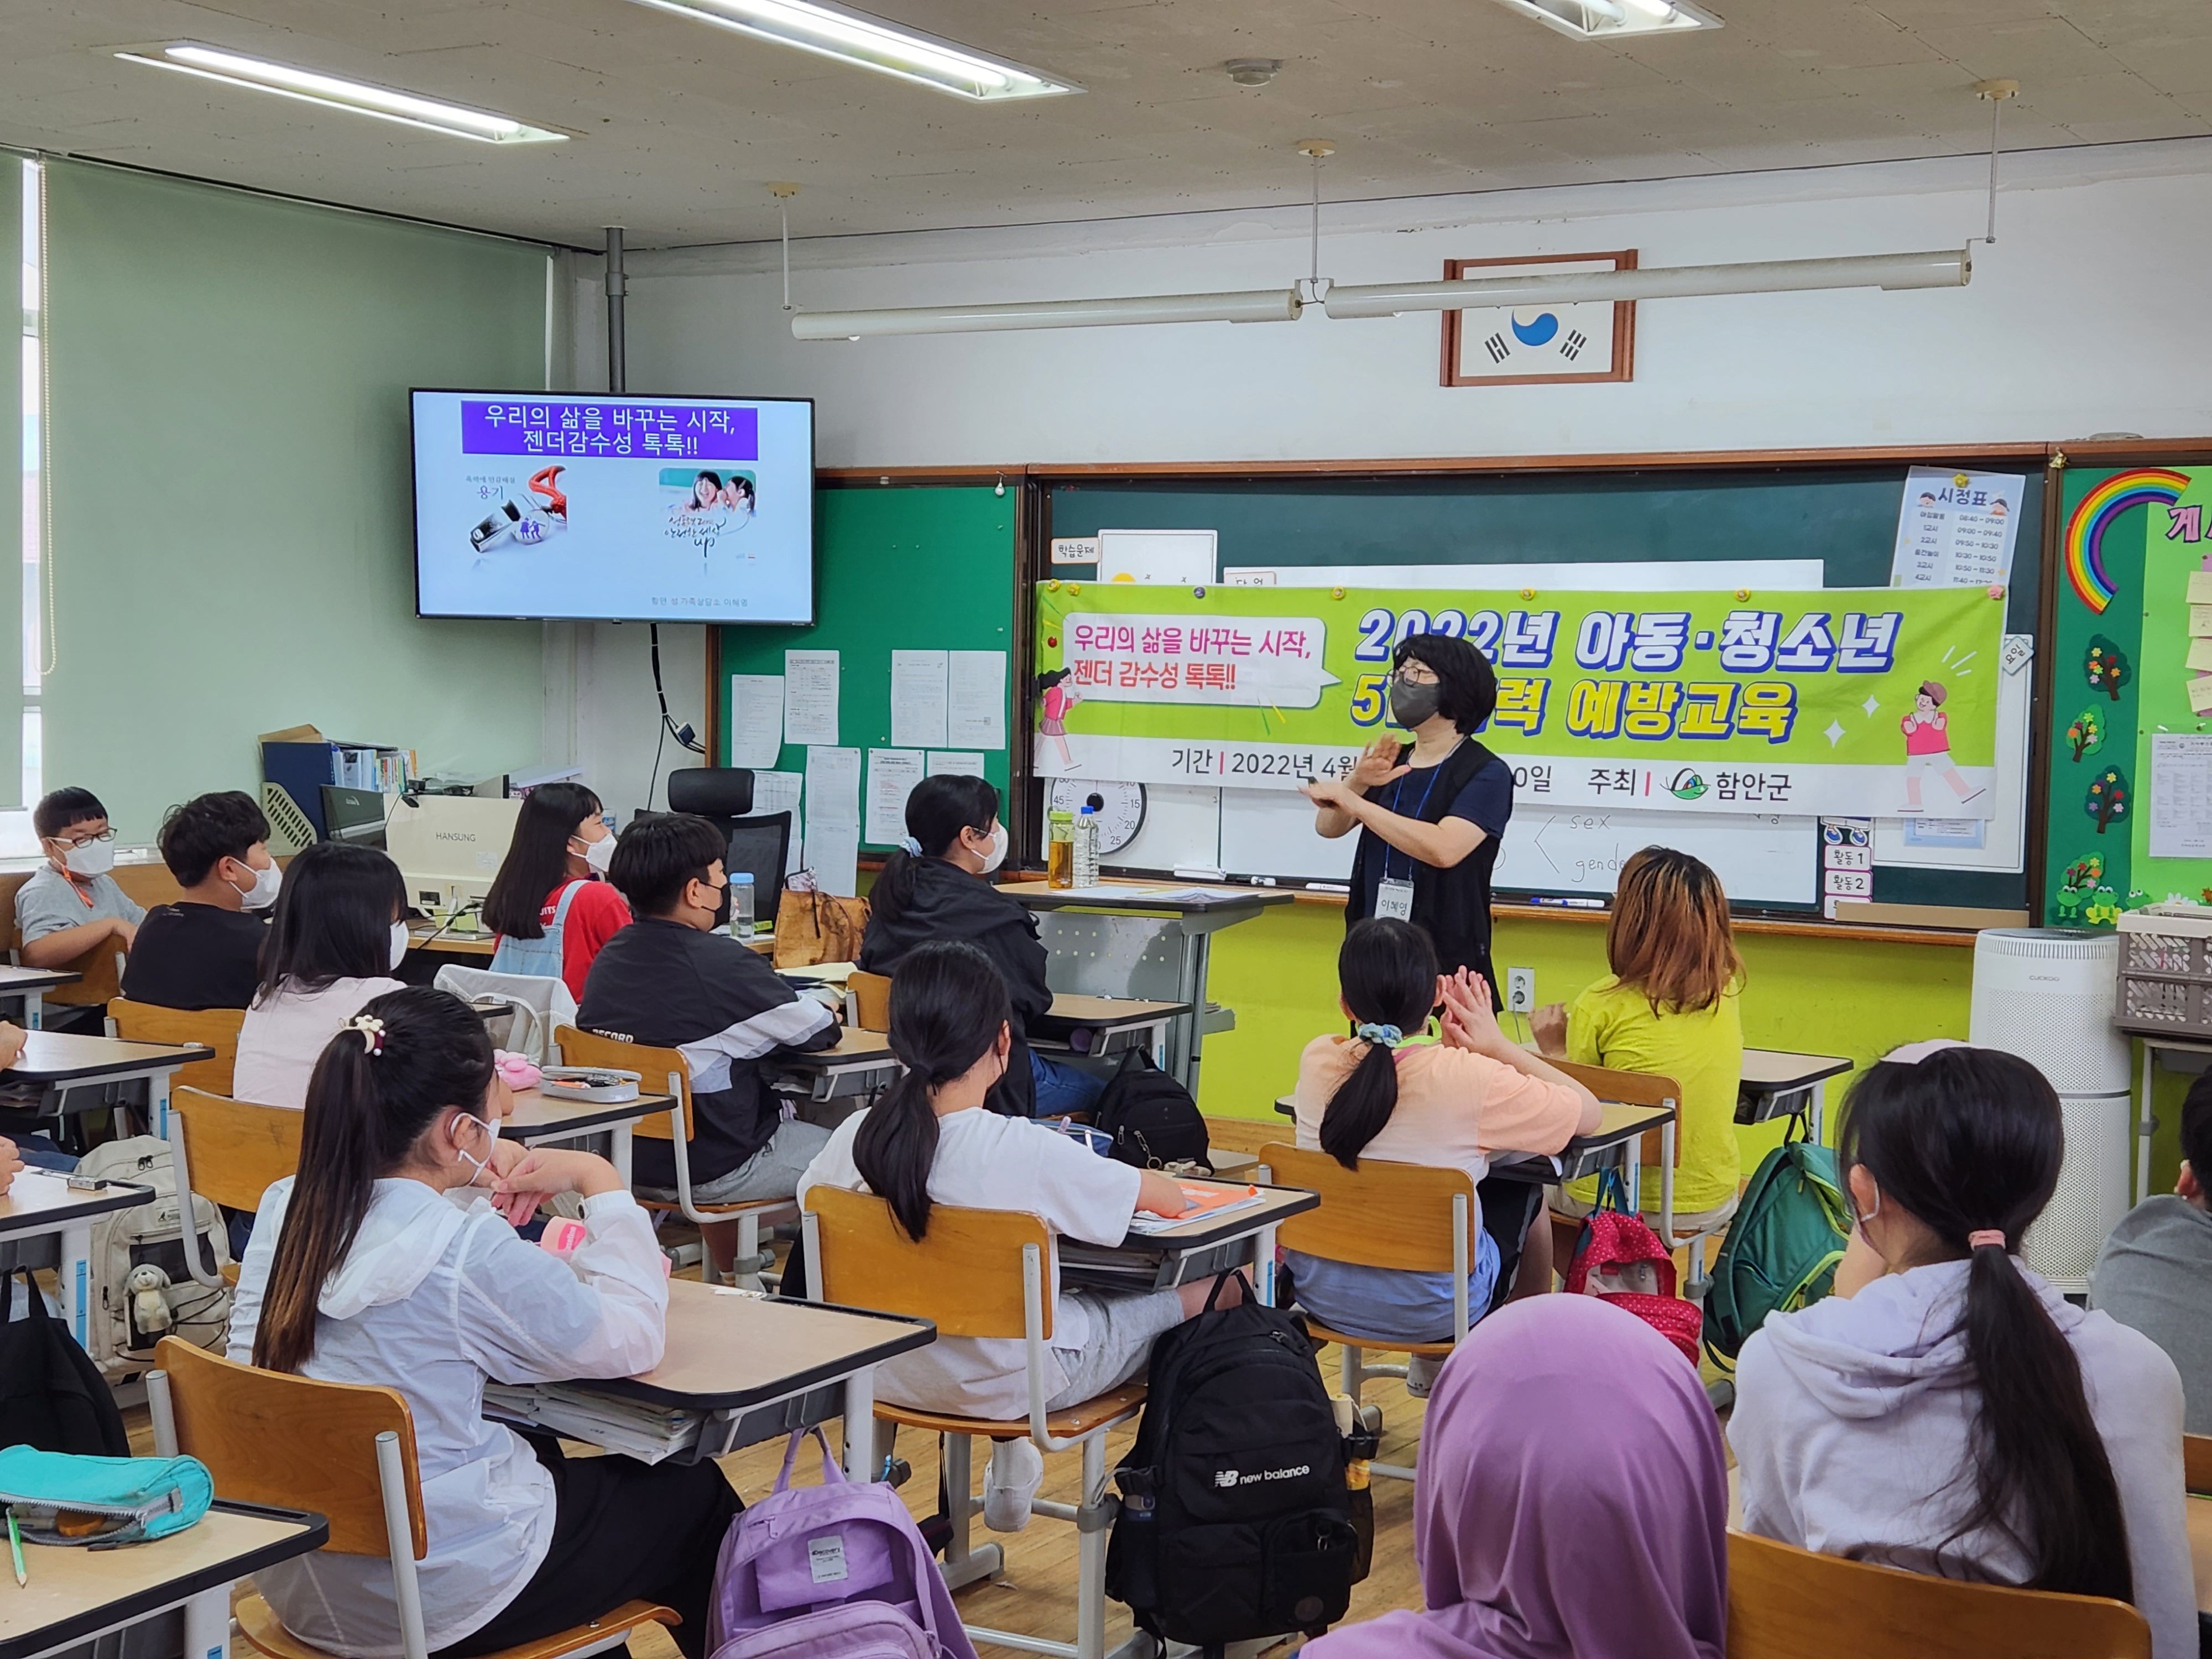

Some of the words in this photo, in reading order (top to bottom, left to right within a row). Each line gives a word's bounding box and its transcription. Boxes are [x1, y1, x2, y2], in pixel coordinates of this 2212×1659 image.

[484, 405, 550, 429] 우리의
[560, 406, 603, 430] 삶을
[613, 408, 678, 432] 바꾸는
[687, 410, 735, 435] 시작,
[523, 430, 633, 455] 젠더감수성
[642, 433, 699, 456] 톡톡!!
[1938, 487, 1987, 507] 시정표
[1985, 517, 2005, 525] 09:00
[2164, 504, 2212, 543] 게
[1983, 529, 2002, 538] 09:40
[1058, 544, 1095, 559] 학습문제
[1074, 625, 1135, 653] 우리의
[1141, 627, 1182, 654] 삶을
[1190, 628, 1252, 656] 바꾸는
[1258, 630, 1311, 659] 시작,
[1575, 610, 1903, 673] 아동·청소년
[2006, 644, 2026, 665] 요일
[1074, 660, 1113, 686] 젠더
[1119, 661, 1178, 689] 감수성
[1185, 662, 1235, 690] 톡톡!!
[1350, 674, 1551, 736] 5력
[1567, 679, 1797, 744] 예방교육
[1172, 748, 1213, 774] 기간
[1232, 753, 1313, 779] 2022년
[1588, 769, 1636, 796] 주최
[1716, 771, 1792, 801] 함안군
[1053, 795, 1064, 805] 45
[1130, 799, 1140, 808] 15
[1124, 821, 1135, 830] 20
[1569, 814, 1611, 830] sex
[436, 832, 476, 842] HANSUNG
[1110, 836, 1121, 845] 25
[1834, 850, 1853, 865] 활동
[1858, 853, 1863, 864] 1
[1833, 874, 1853, 891] 활동
[1855, 878, 1864, 890] 2
[1240, 1473, 1262, 1485] new
[1264, 1465, 1310, 1480] balance
